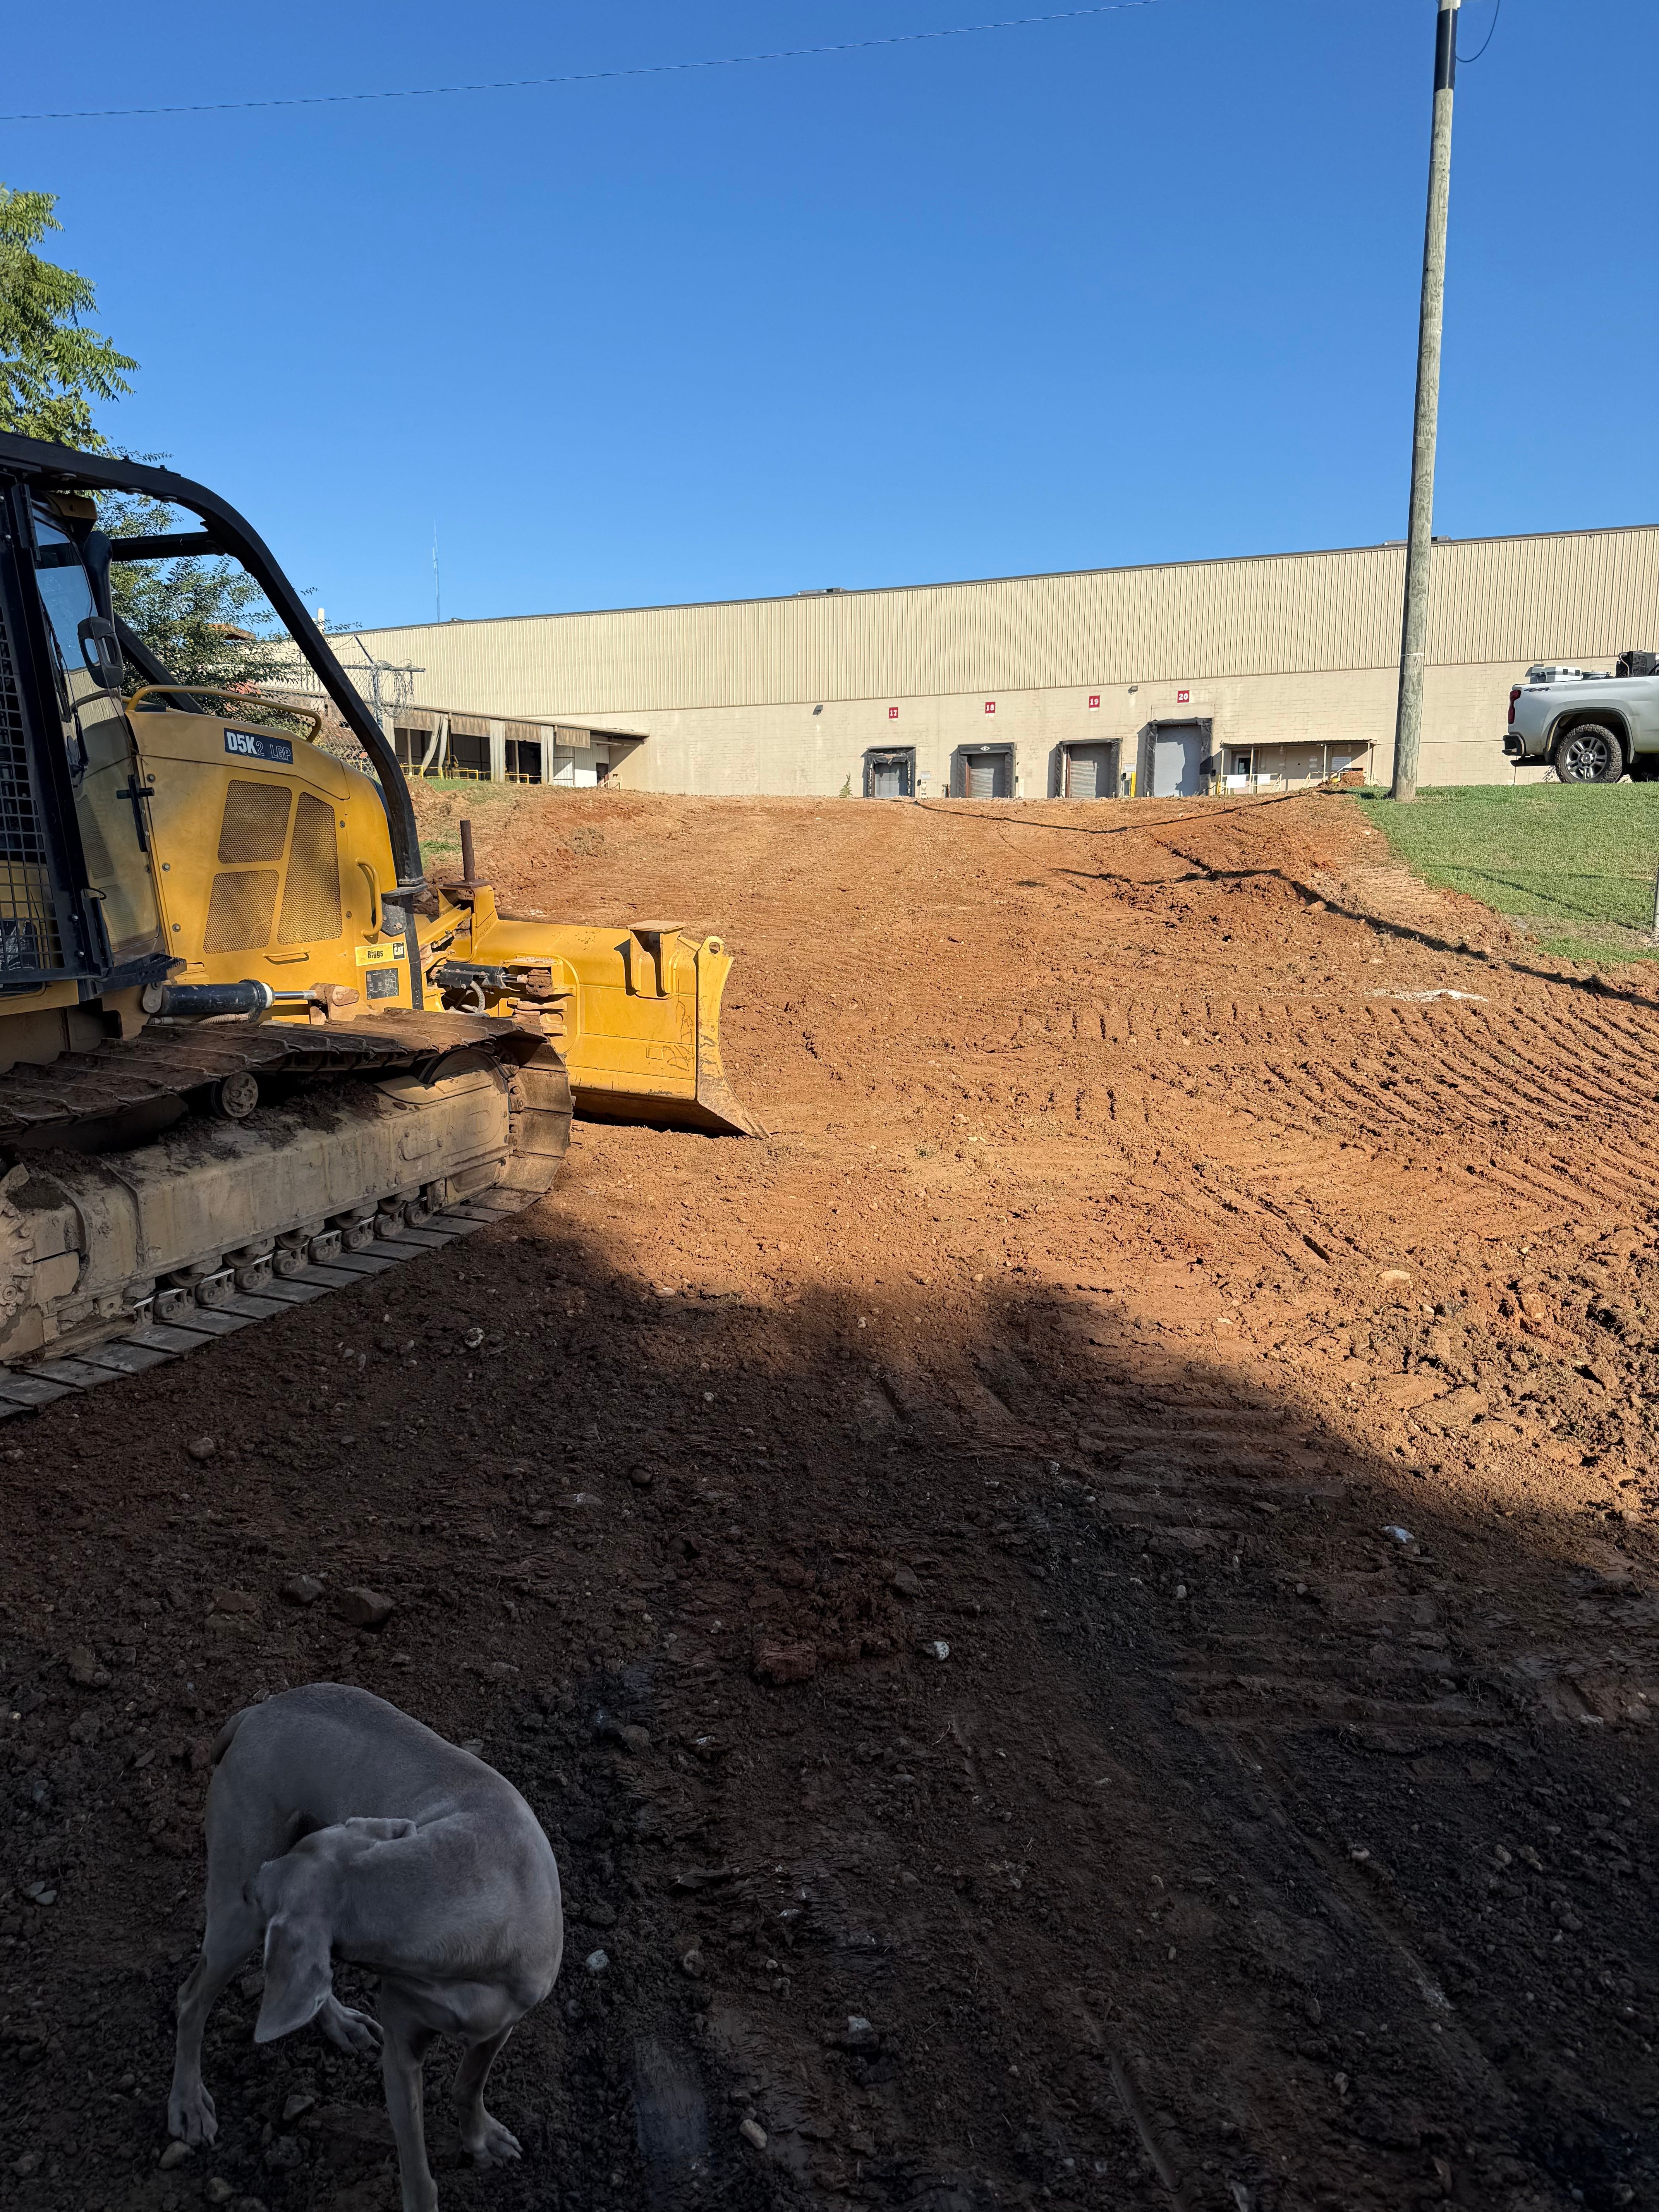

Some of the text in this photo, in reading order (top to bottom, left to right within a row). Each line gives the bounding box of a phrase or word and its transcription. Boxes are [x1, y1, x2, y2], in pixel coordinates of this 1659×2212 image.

[270, 744, 291, 761] LGP
[368, 946, 404, 959] Riggs CAT
